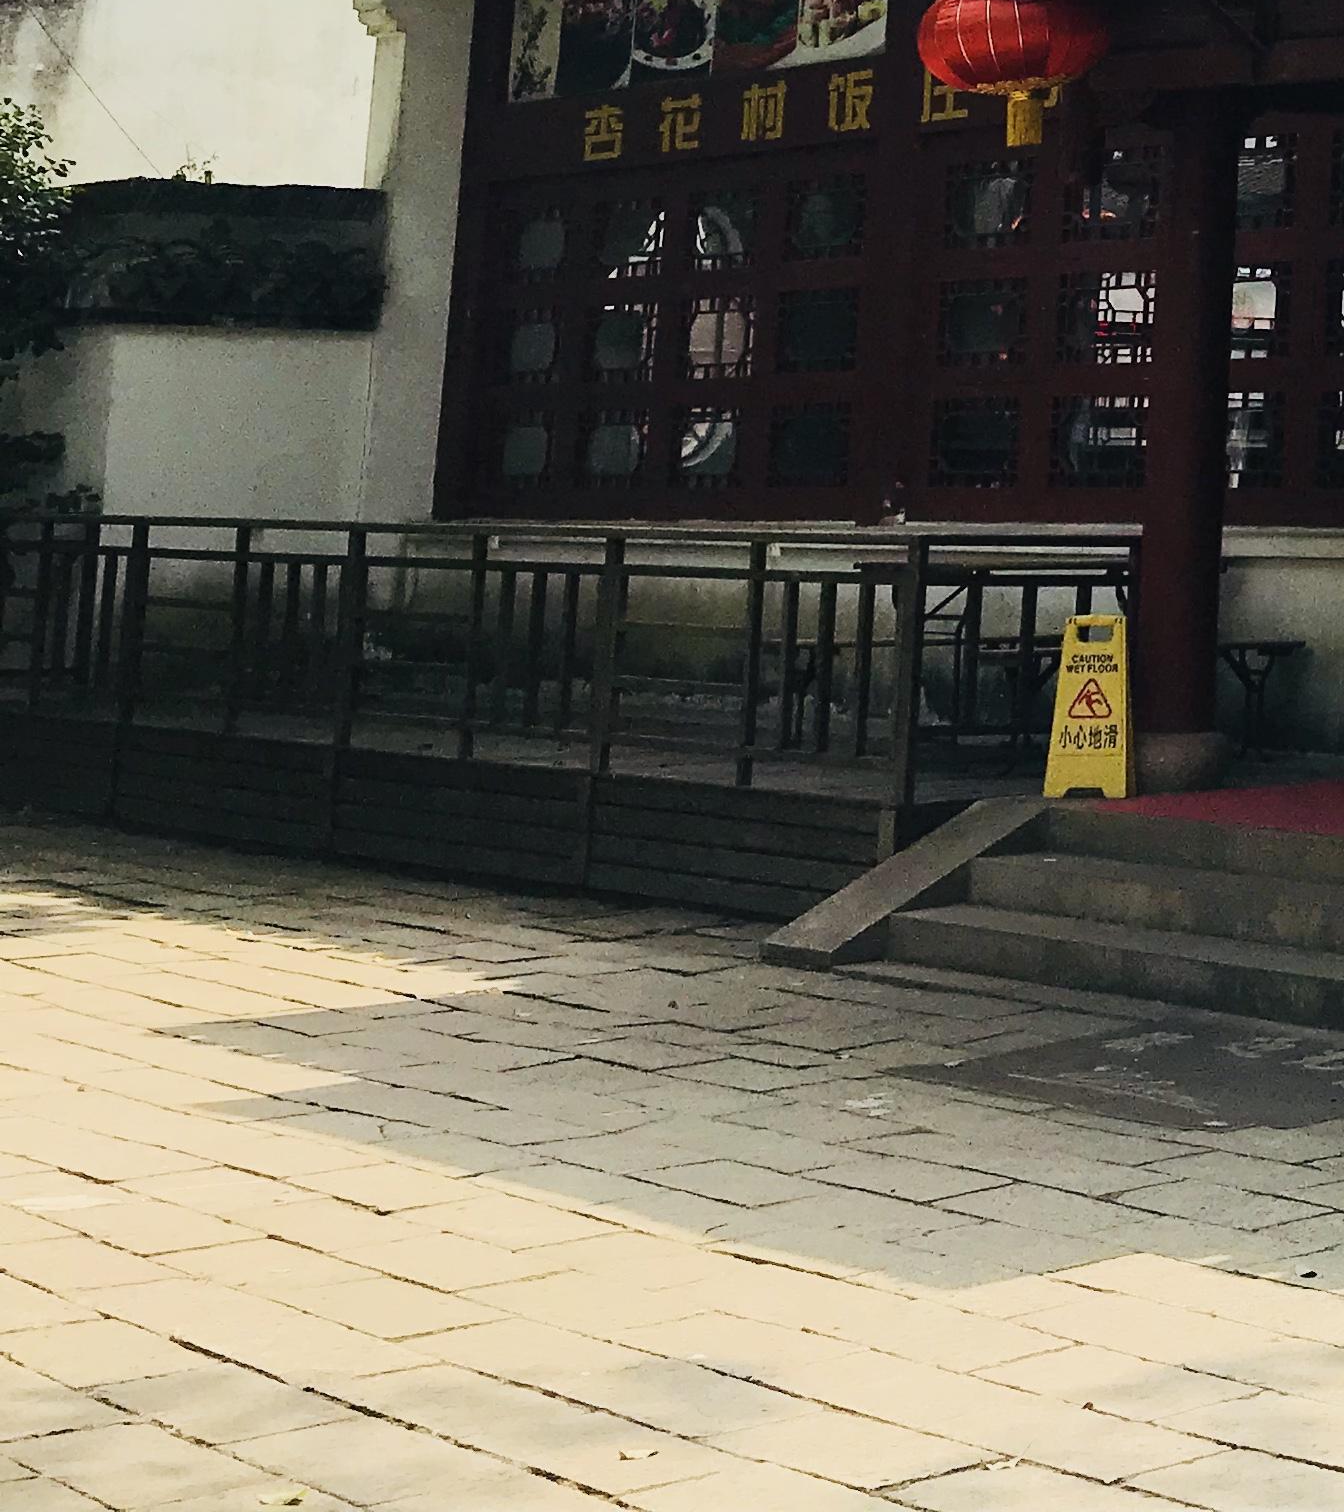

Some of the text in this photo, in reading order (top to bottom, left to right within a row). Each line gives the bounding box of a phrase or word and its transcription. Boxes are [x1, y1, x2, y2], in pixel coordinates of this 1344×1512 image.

[1071, 654, 1114, 664] CAUTION
[1066, 663, 1118, 674] WET FLOOR
[1059, 724, 1119, 749] 小心地滑
